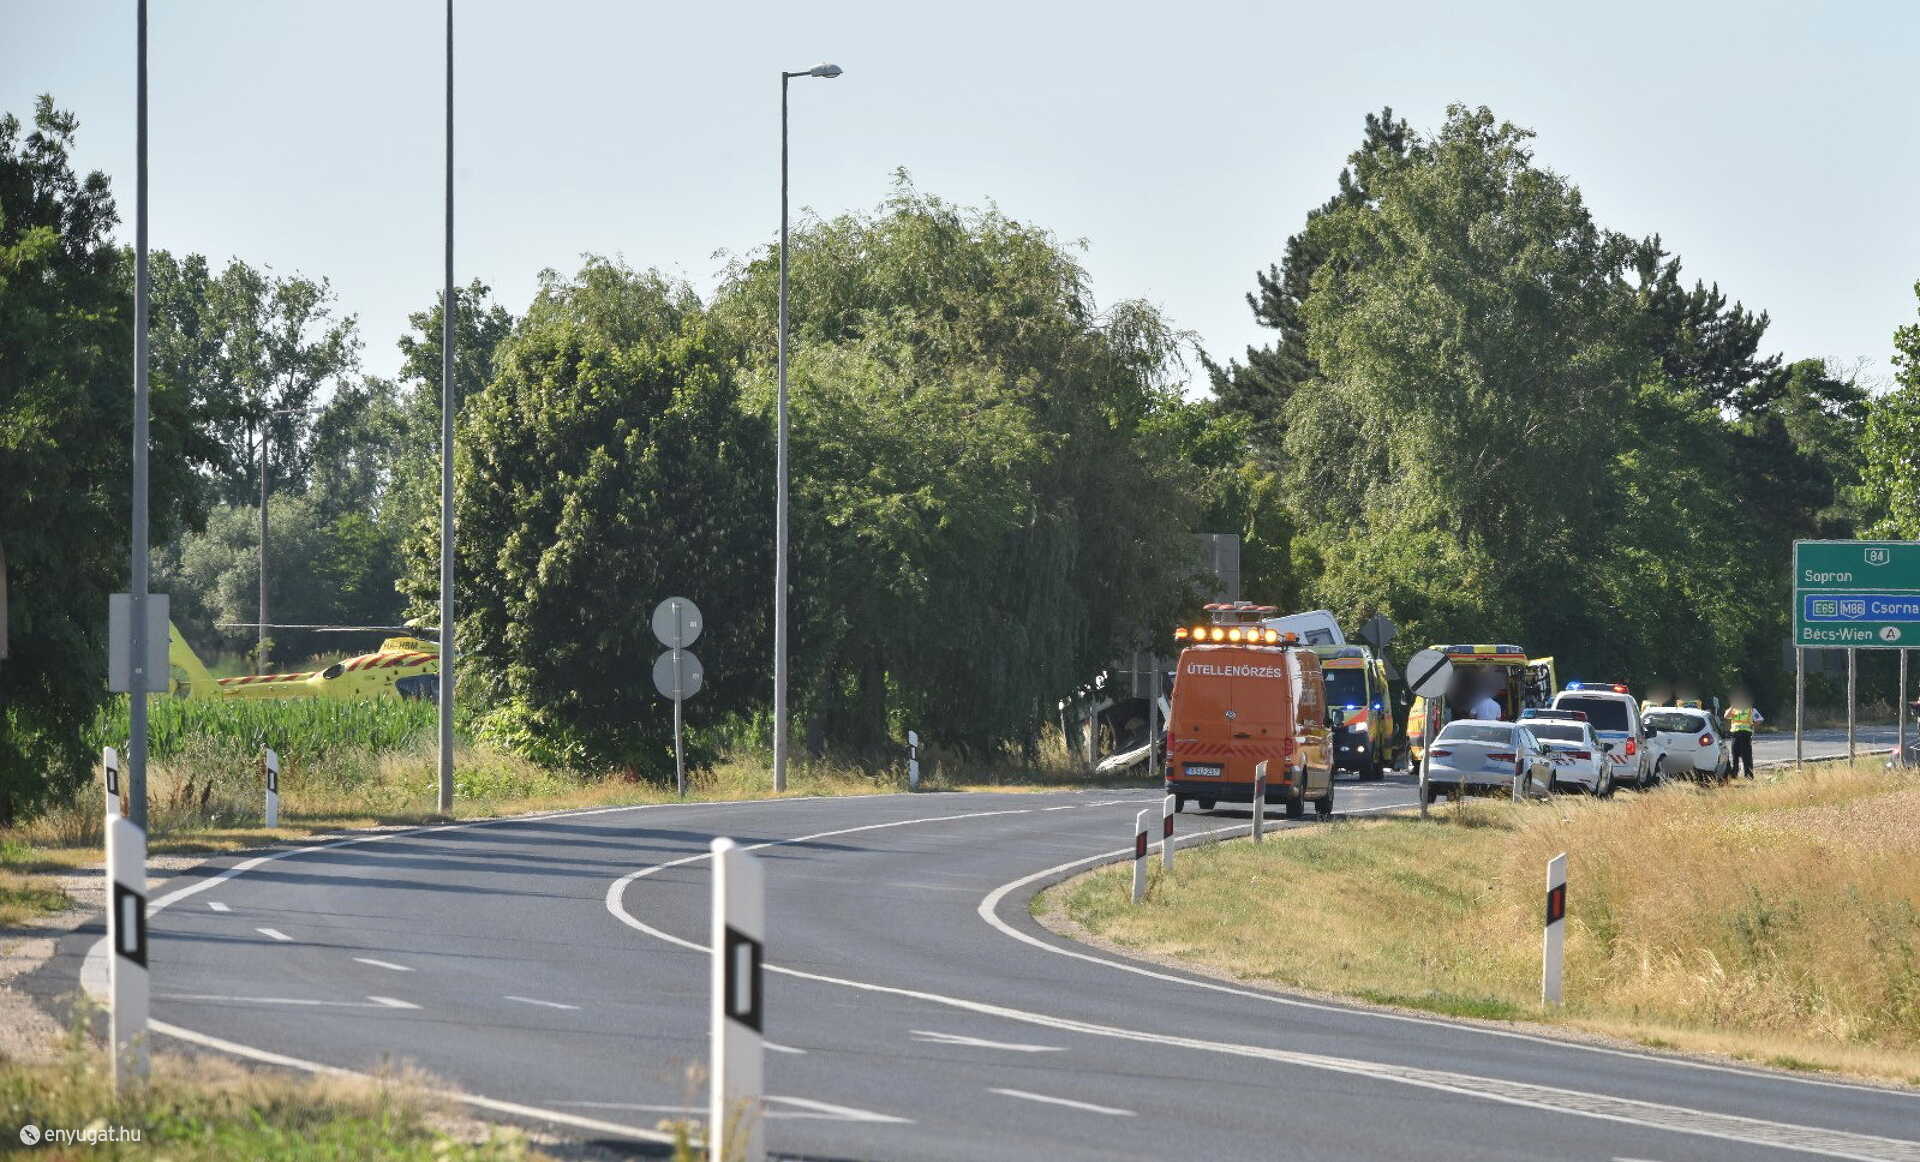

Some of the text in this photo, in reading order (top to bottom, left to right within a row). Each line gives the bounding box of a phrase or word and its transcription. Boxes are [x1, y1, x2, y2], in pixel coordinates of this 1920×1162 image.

[1870, 550, 1884, 561] 84
[1804, 569, 1853, 584] Sopron
[1815, 601, 1919, 614] E65 M86 Csorna
[1803, 627, 1896, 640] Bécs-Wien A
